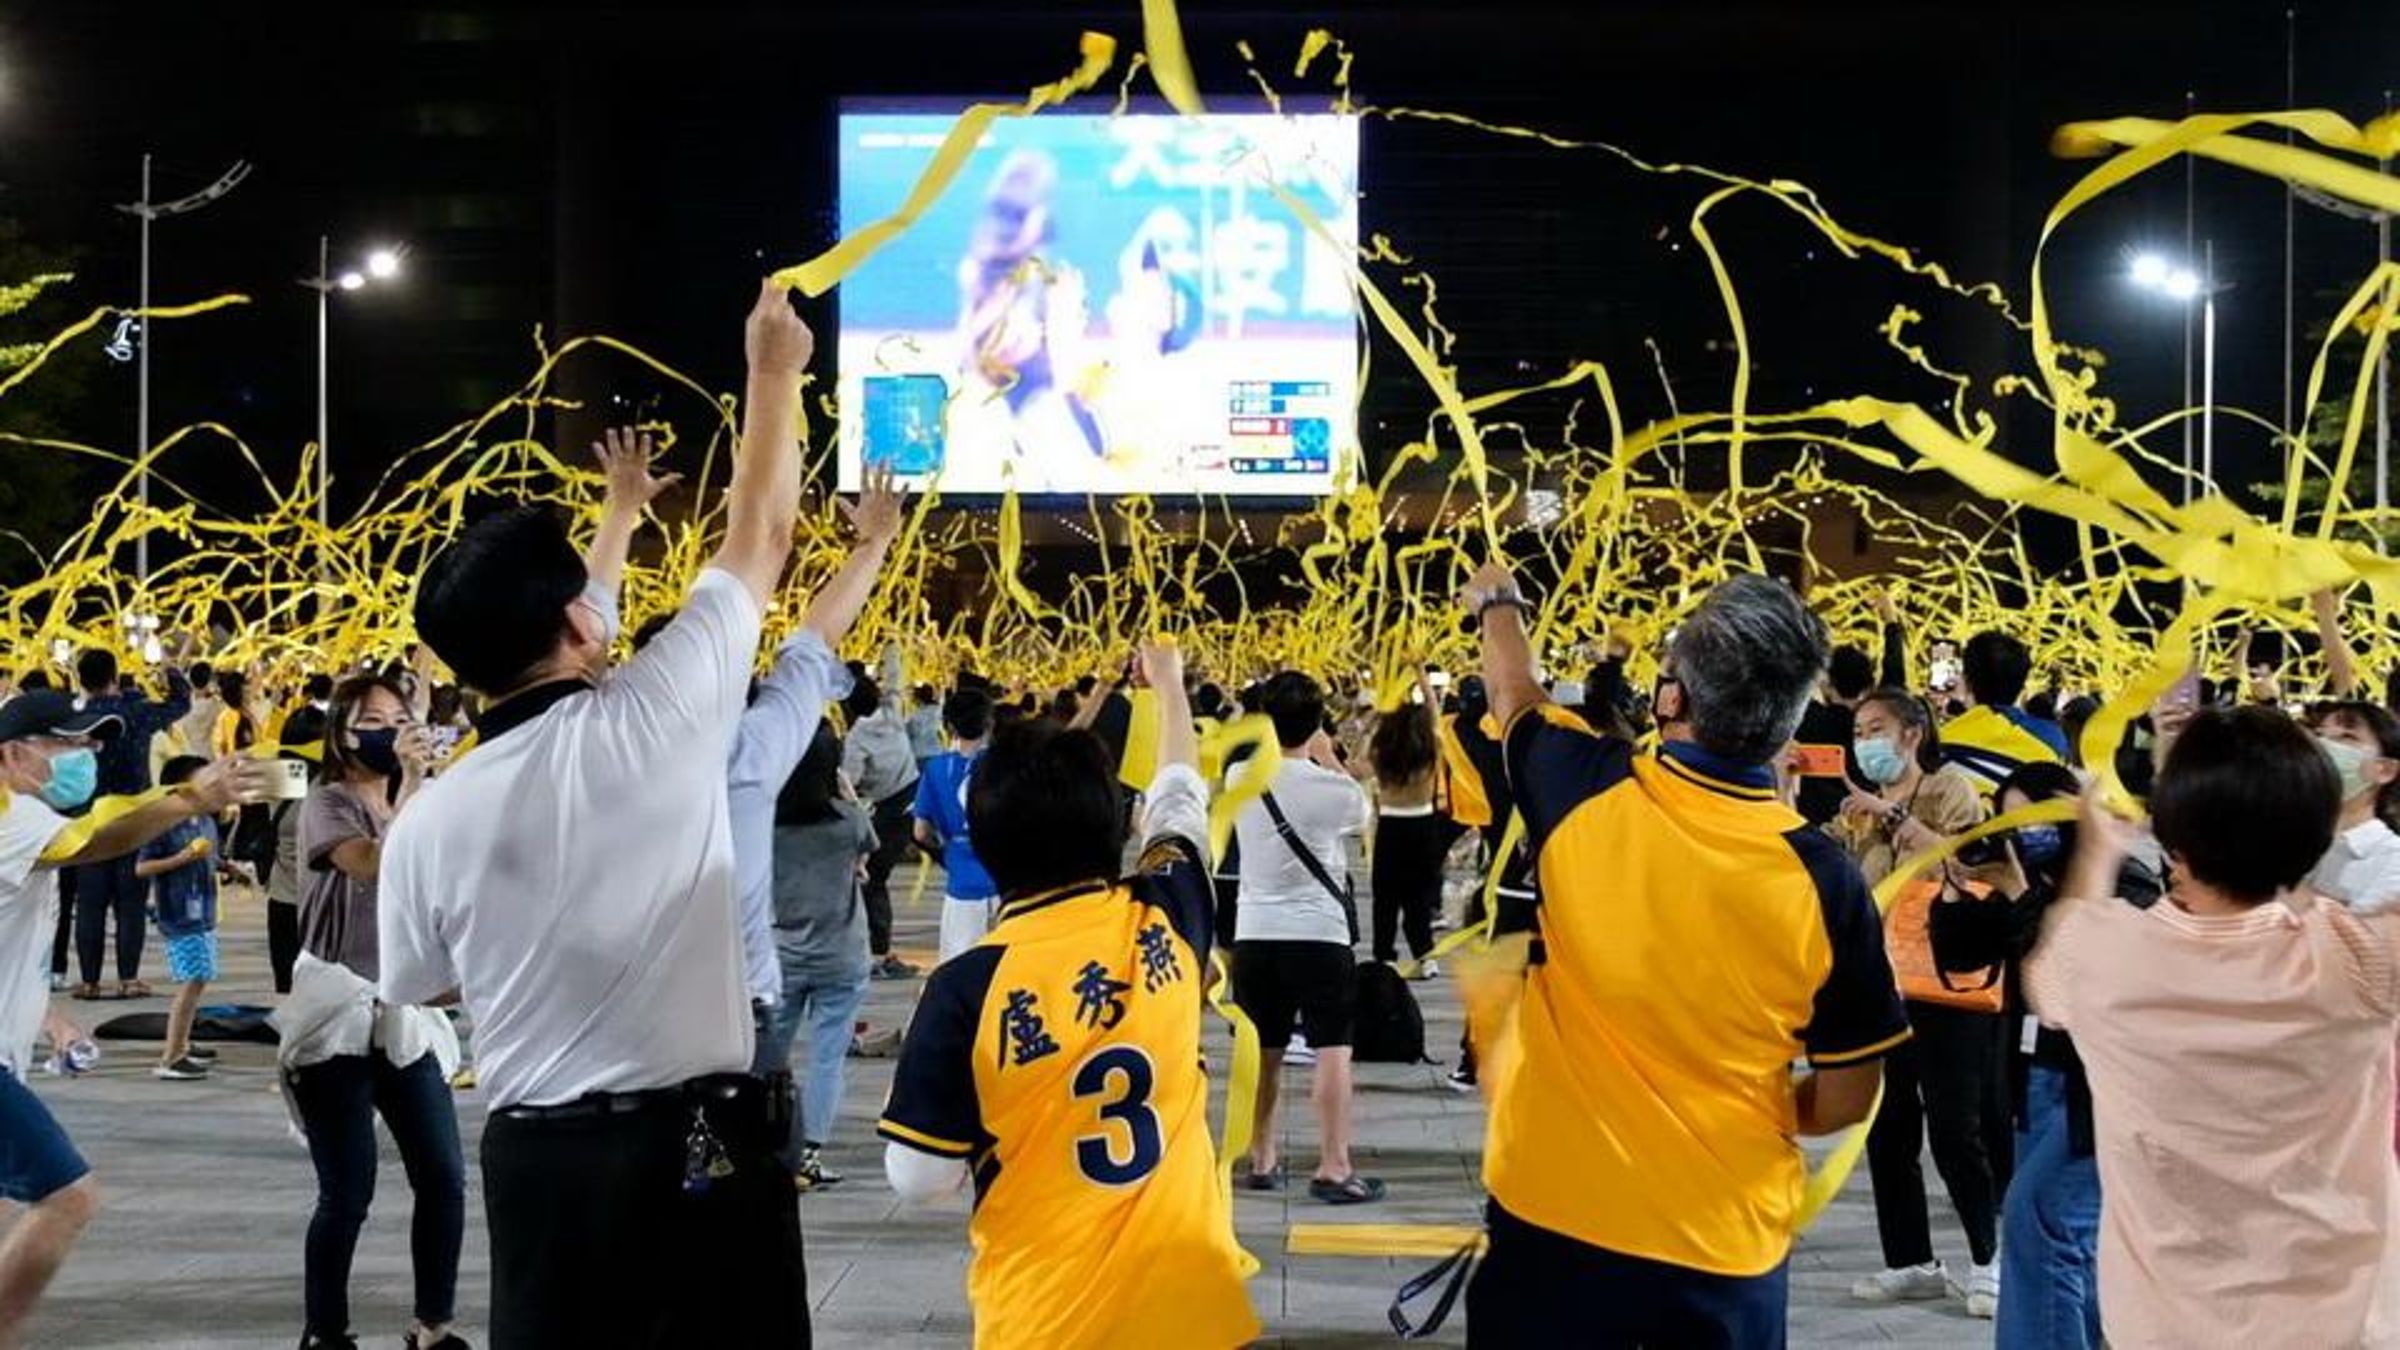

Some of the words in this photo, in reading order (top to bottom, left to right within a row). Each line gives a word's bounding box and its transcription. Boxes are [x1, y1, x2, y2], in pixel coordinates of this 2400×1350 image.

[999, 922, 1182, 1070] 盧秀燕
[1071, 1043, 1163, 1187] 3
